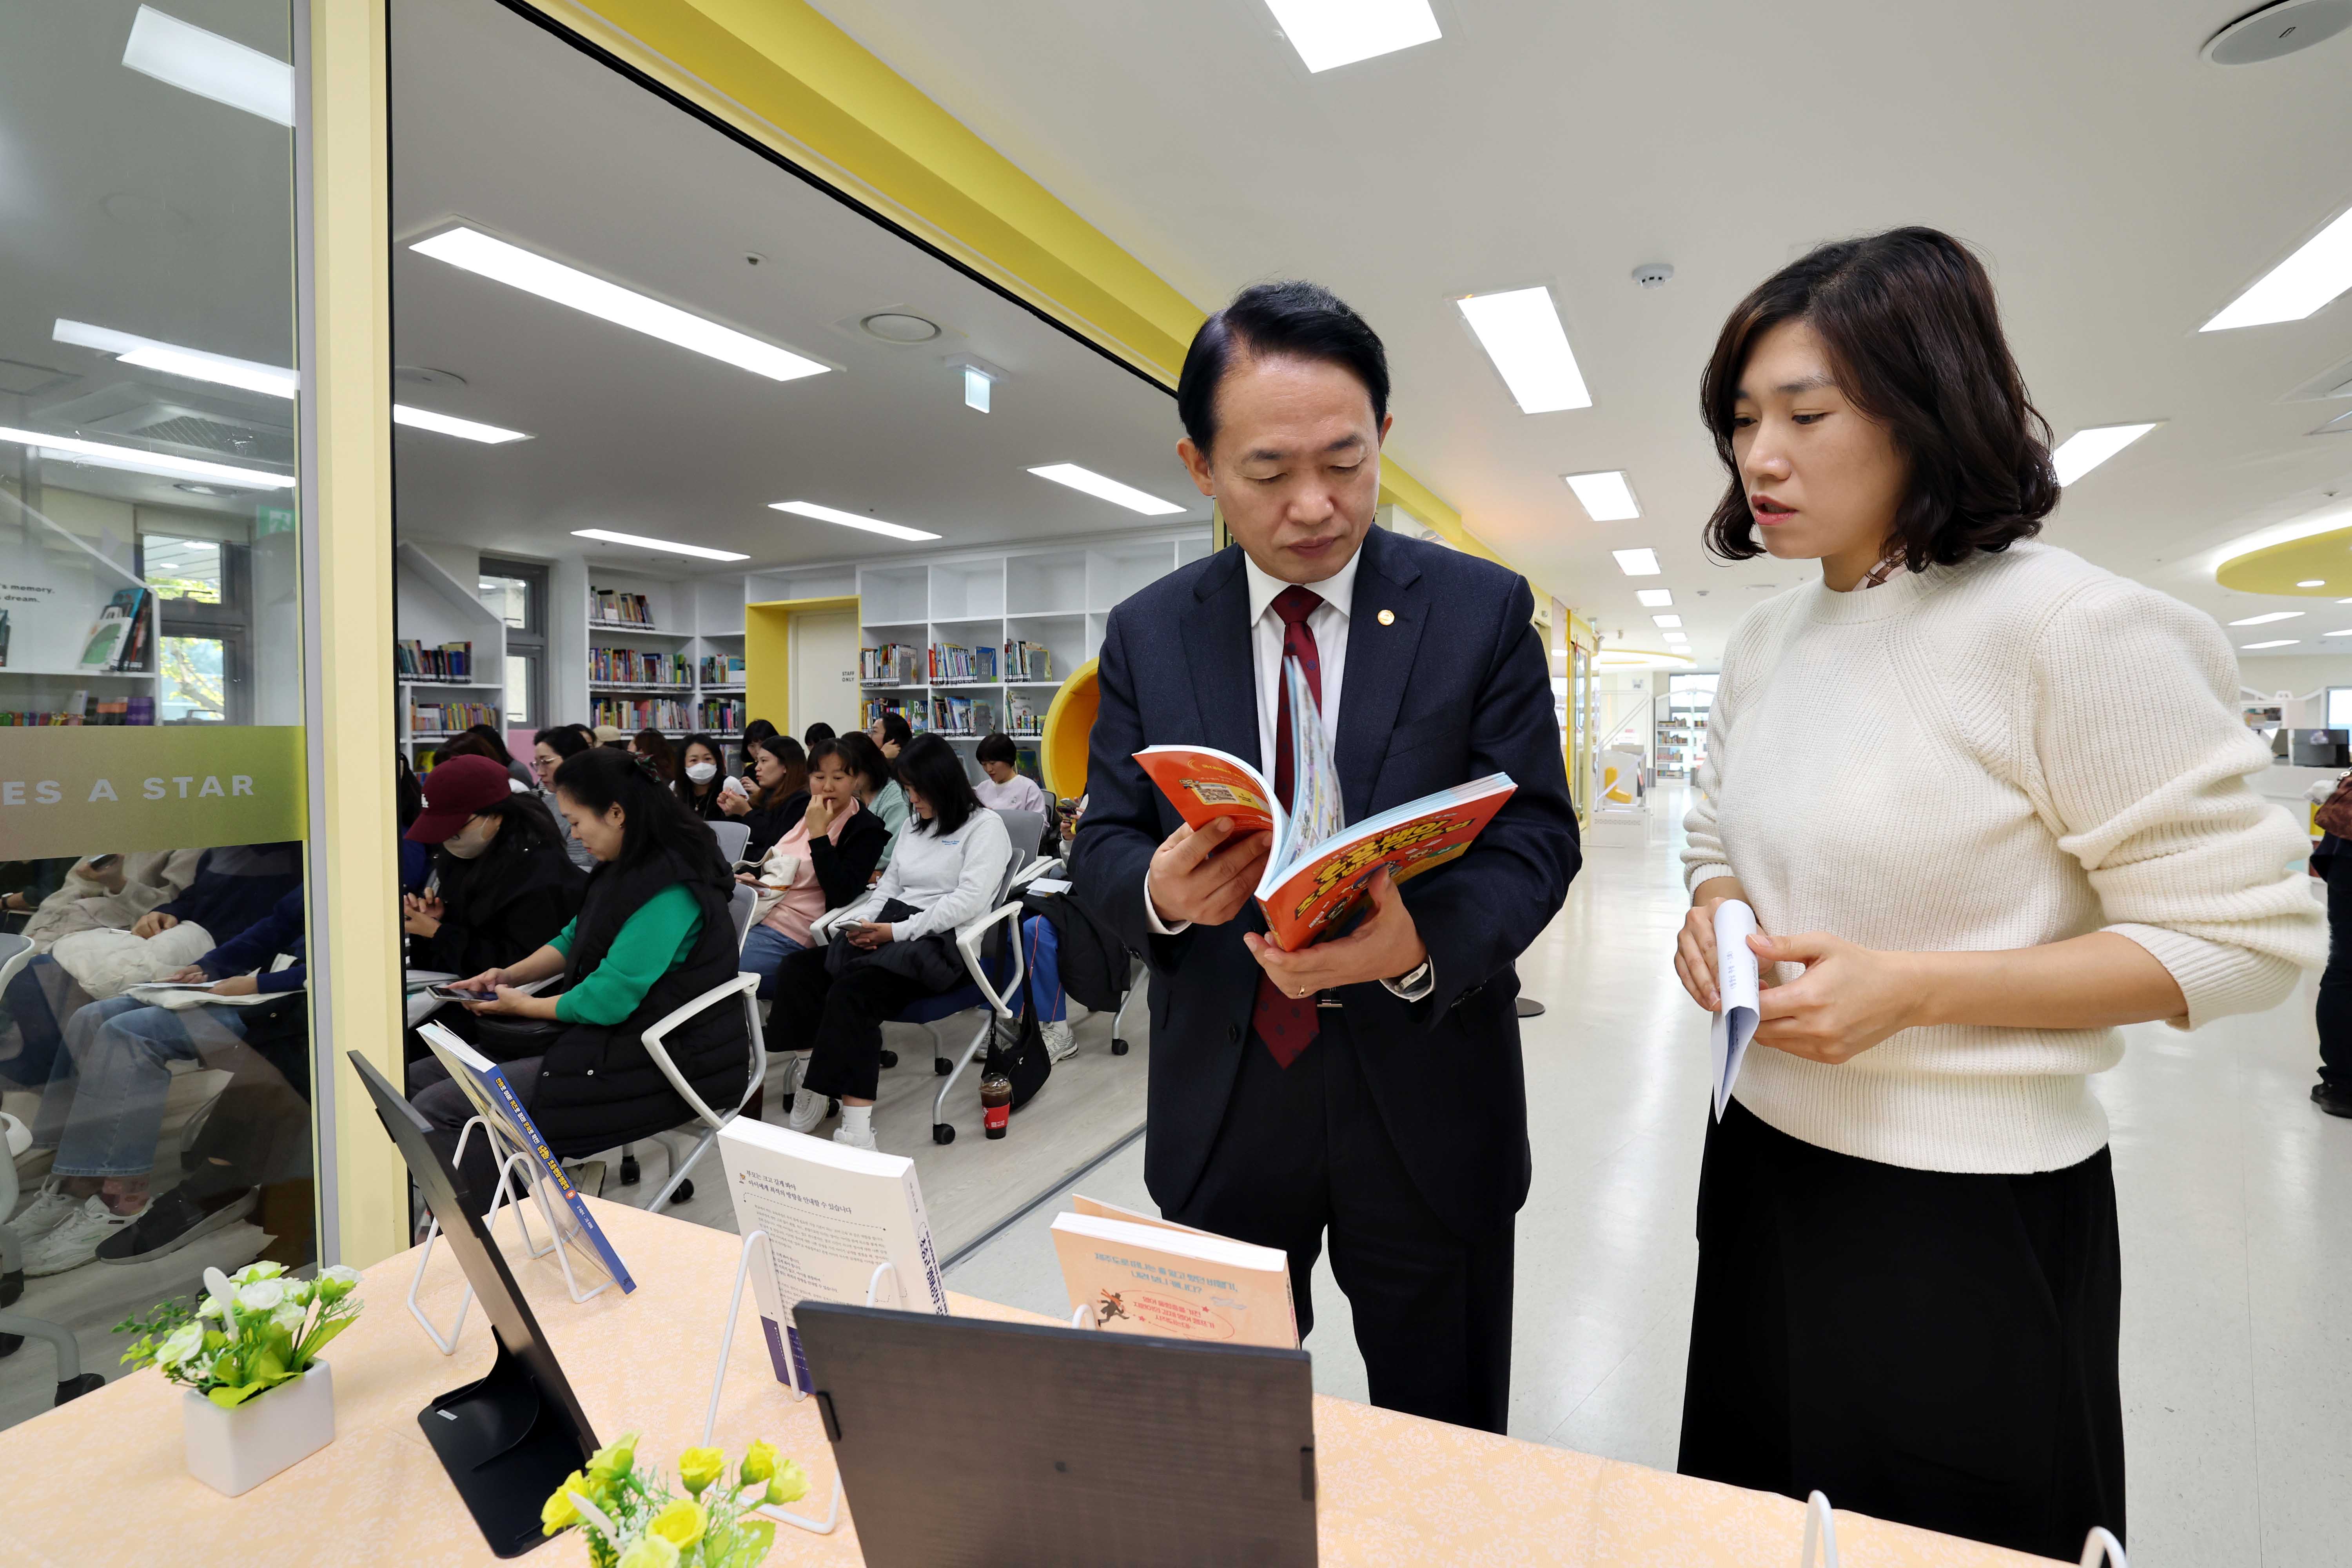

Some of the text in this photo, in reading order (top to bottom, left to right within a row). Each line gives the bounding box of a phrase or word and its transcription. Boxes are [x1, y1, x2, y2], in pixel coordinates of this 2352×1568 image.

[11, 585, 55, 594] memory.
[3, 775, 254, 805] ES A STAR
[1314, 819, 1452, 884] 혼공쌤의
[495, 1077, 506, 1091] 만화로
[503, 1090, 513, 1101] 이해!
[510, 1100, 521, 1113] 퀴즈로
[517, 1112, 527, 1123] 정리!
[523, 1122, 534, 1135] 문제로
[532, 1134, 541, 1145] 확인!
[746, 1170, 761, 1180] 부모는
[785, 1182, 796, 1191] 봐야
[748, 1180, 769, 1191] 아이에게
[770, 1187, 785, 1197] 최적의
[786, 1192, 802, 1201] 방향을
[803, 1197, 819, 1207] 안내할
[828, 1203, 852, 1214] 있습니다
[920, 1237, 930, 1269] 초중고
[927, 1266, 940, 1305] 영어공부
[1095, 1252, 1129, 1266] 제주도로
[1130, 1260, 1156, 1272] 떠나는
[1168, 1269, 1185, 1280] 알고
[1206, 1278, 1238, 1292] 비행기,
[1131, 1270, 1202, 1294] 내려 보니 캐나다?
